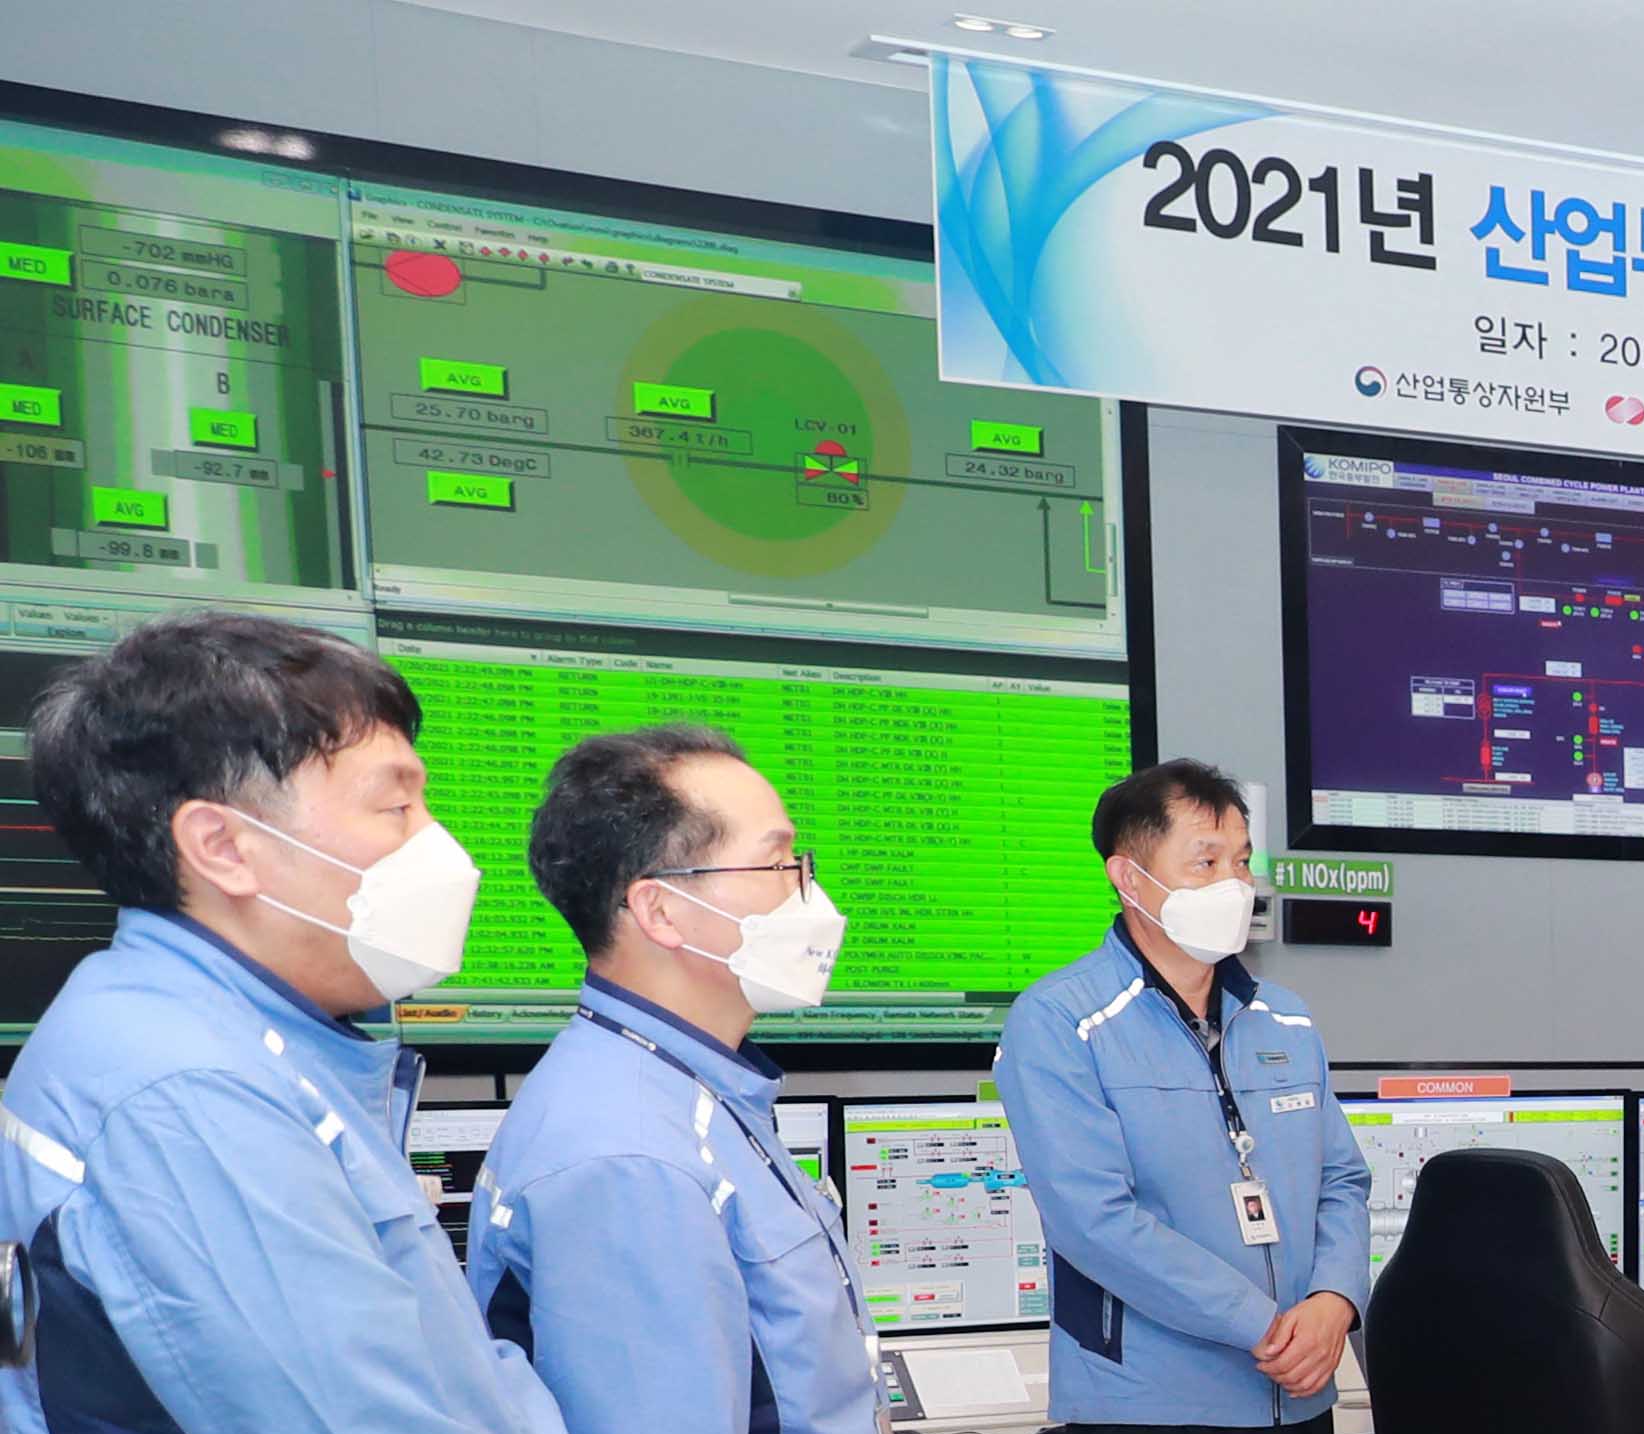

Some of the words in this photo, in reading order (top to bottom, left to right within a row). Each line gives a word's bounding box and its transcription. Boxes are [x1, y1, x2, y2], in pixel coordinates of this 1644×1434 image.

[1142, 139, 1437, 271] 2021년
[122, 241, 175, 260] -702
[9, 257, 47, 274] MED
[106, 271, 177, 294] 0.076
[53, 294, 153, 329] SURFACE
[166, 310, 291, 347] CONDENSER
[1474, 313, 1548, 361] 일자
[1568, 331, 1578, 357] :
[216, 372, 230, 394] B
[446, 372, 481, 386] AVG
[1395, 369, 1571, 416] 산업통상자원부
[12, 400, 41, 416] MED
[658, 396, 691, 410] AVG
[415, 402, 481, 421] 25.70
[487, 410, 536, 430] barg
[210, 421, 239, 438] MED
[992, 433, 1022, 446] AVG
[418, 447, 485, 465] 42.73
[488, 454, 538, 472] DegC
[1328, 457, 1392, 475] KOMIPO
[965, 461, 1020, 478] 24.32
[1024, 467, 1065, 485] barg
[453, 485, 488, 499] AVG
[115, 501, 145, 518] AVG
[1275, 862, 1296, 886] #1
[1302, 863, 1390, 893] NOx(ppm)
[1357, 909, 1379, 935] 4
[1416, 1080, 1475, 1095] COMMON
